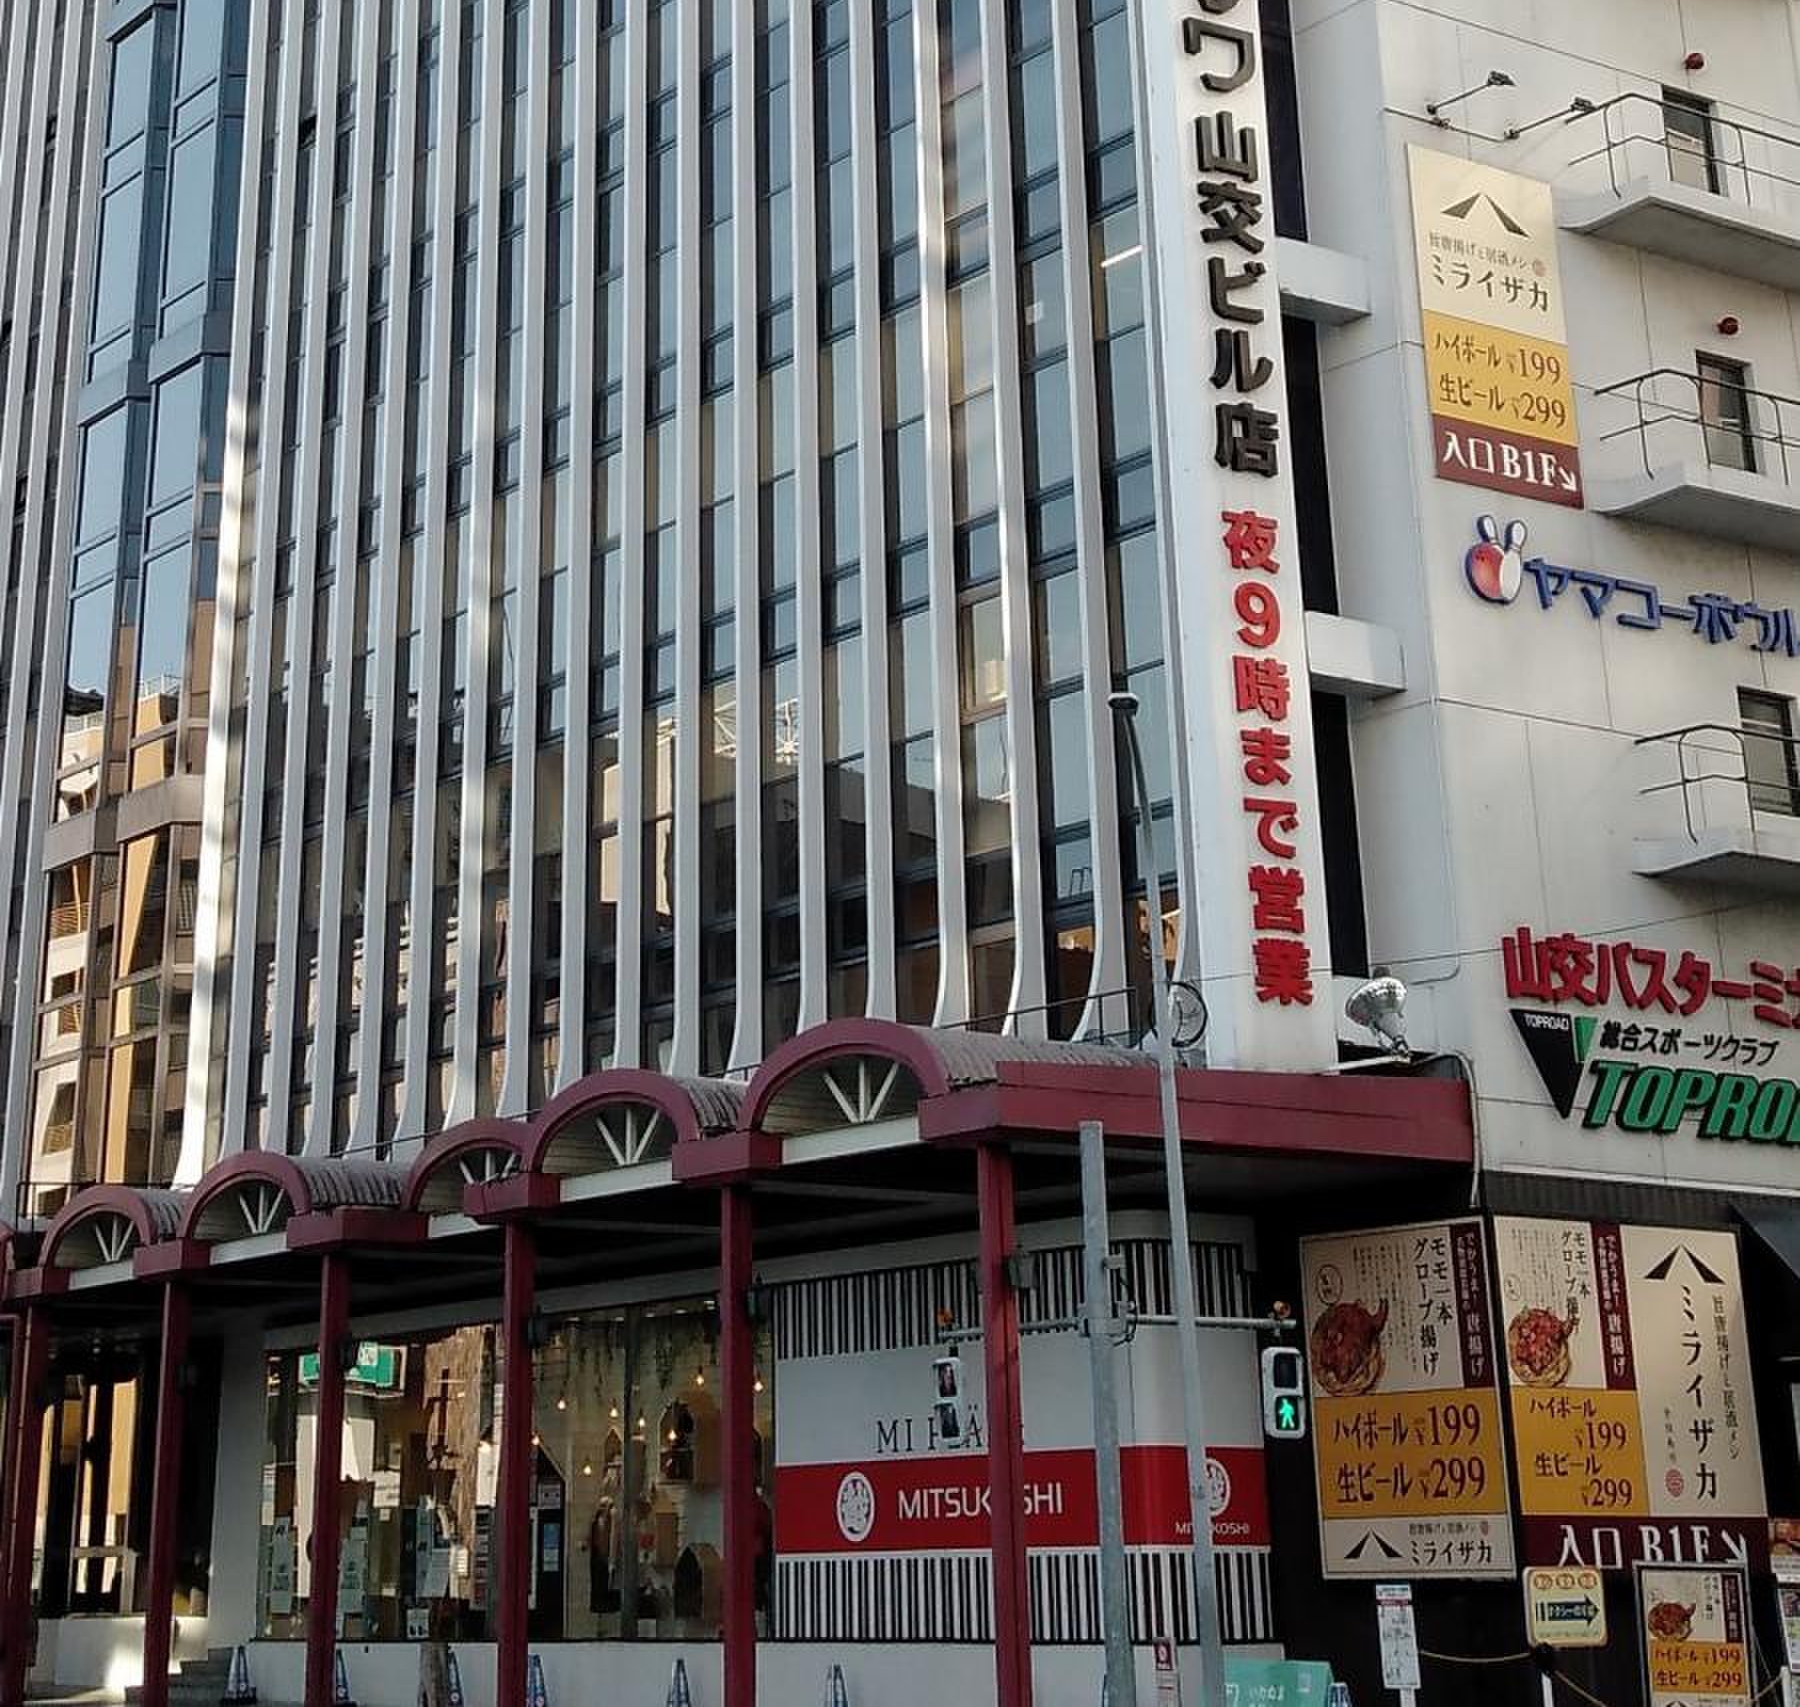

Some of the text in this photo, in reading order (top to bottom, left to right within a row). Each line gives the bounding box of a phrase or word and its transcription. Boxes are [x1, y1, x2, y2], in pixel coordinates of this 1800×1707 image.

[1431, 254, 1549, 312] ミライザカ
[1436, 332, 1501, 368] ハイボール
[1439, 372, 1505, 411] 生ビール
[1221, 509, 1314, 1006] 夜9時まで営業
[1599, 1019, 1780, 1067] 総合スポーツクラブ
[1582, 1058, 1800, 1145] TOPRO
[1529, 1396, 1597, 1418] ハイボール
[1681, 1284, 1717, 1500] ミライザカ
[1334, 1410, 1409, 1450] ハイボール
[1337, 1461, 1413, 1503] 生ビール
[1535, 1451, 1602, 1477] 生ビール
[897, 1482, 1063, 1521] MITSUKSHI
[1409, 1539, 1492, 1566] ミライザカ
